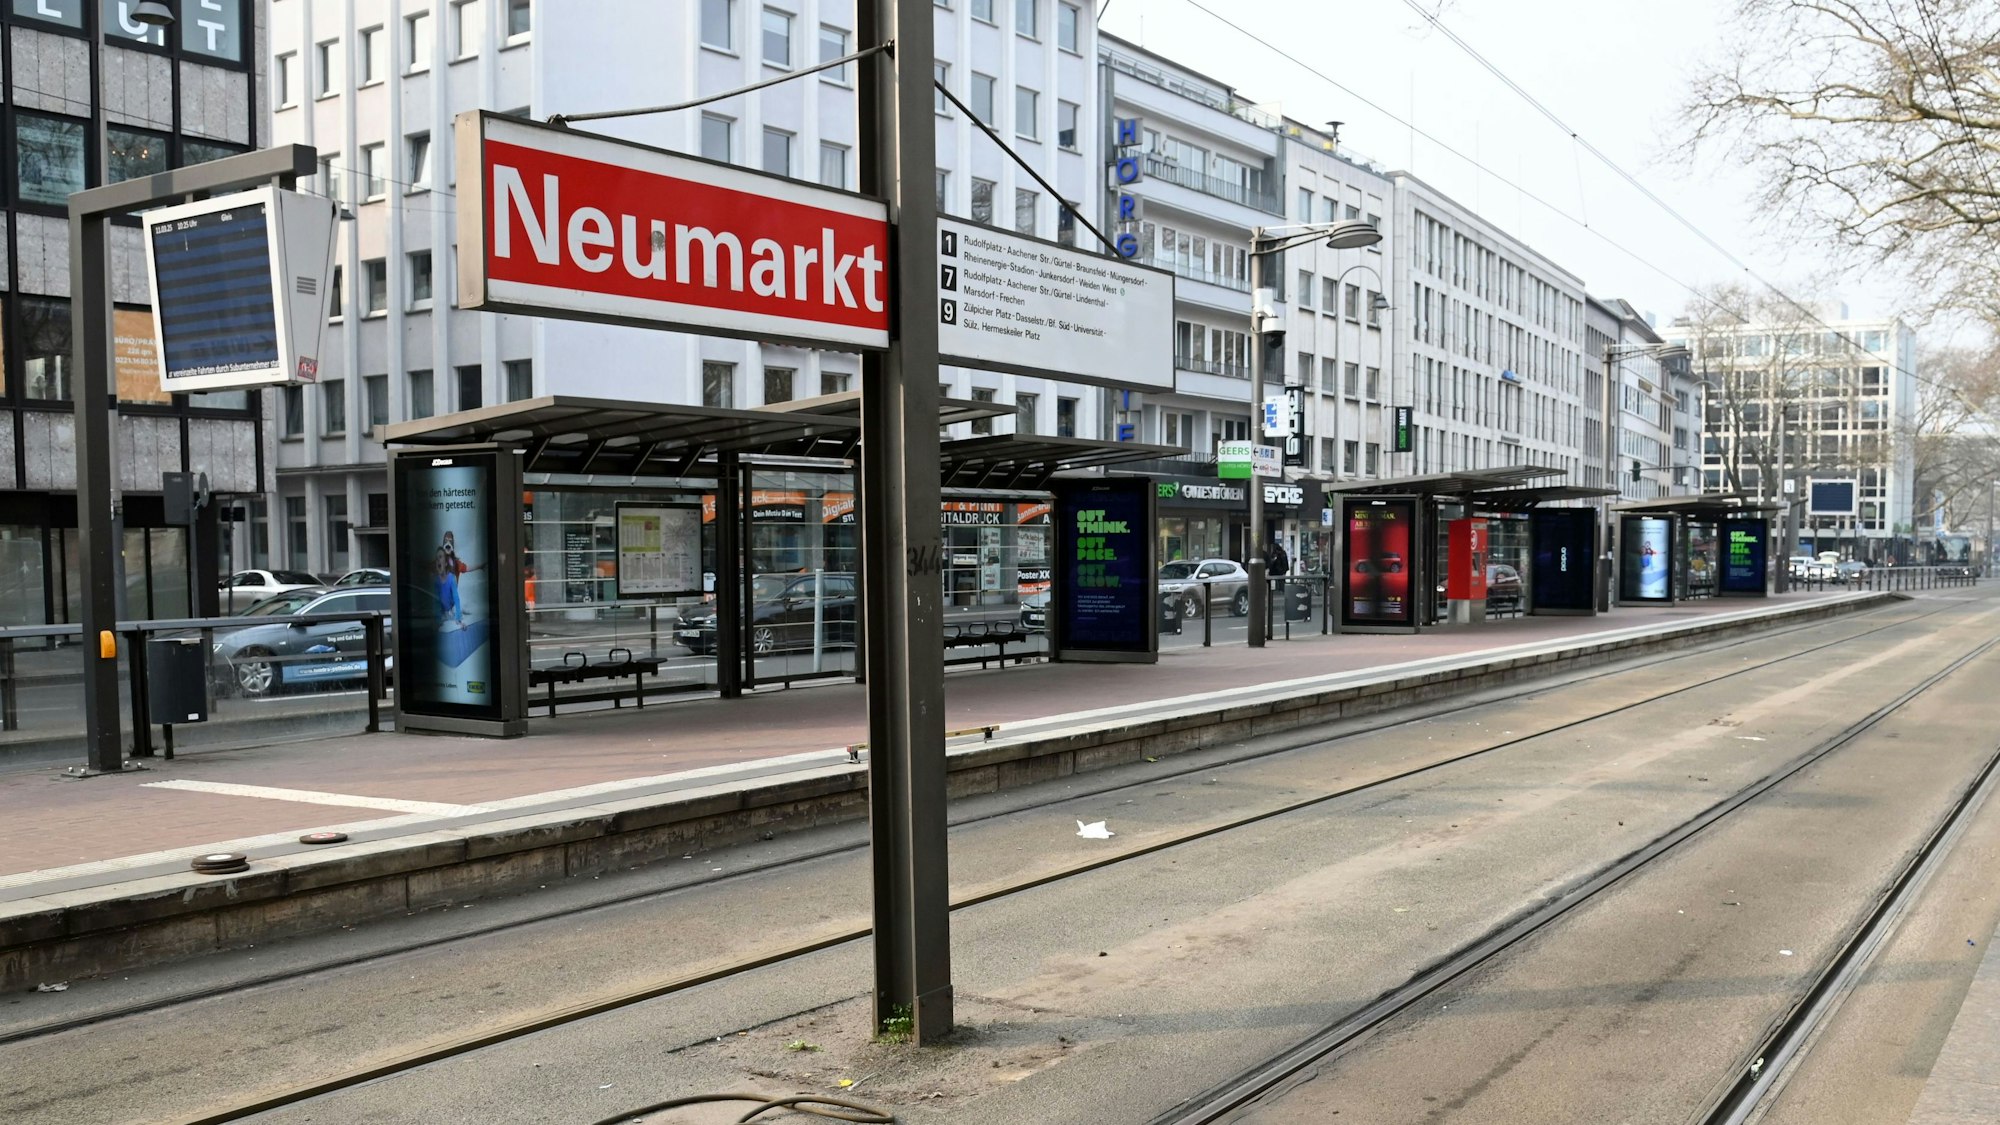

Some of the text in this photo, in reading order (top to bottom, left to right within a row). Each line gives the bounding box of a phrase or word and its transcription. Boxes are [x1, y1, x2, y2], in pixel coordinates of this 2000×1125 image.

[493, 163, 884, 313] Neumarkt
[945, 234, 952, 254] 1
[964, 235, 1002, 253] Rudolfplatz
[1007, 246, 1037, 262] Aachener
[1076, 262, 1106, 278] Braunsfeld
[1109, 271, 1144, 287] Müngersdorf
[944, 268, 954, 287] 7
[1039, 269, 1075, 284] Junkersdorf
[1079, 277, 1101, 290] Weiden
[1101, 283, 1117, 295] West
[963, 268, 1002, 287] Rudolfplatz
[1006, 279, 1037, 293] Aachener
[1075, 293, 1106, 308] Lindenthal
[963, 285, 995, 300] Marsdorf
[999, 292, 1026, 306] Frechen
[943, 302, 954, 322] 9
[963, 302, 994, 316] Zülpicher
[995, 308, 1012, 320] Platz
[1058, 320, 1070, 331] Süd
[963, 318, 1041, 341] Sülz, Hermeskeiler Platz
[1218, 446, 1250, 456] GEERS
[443, 487, 476, 498] härtesten
[445, 500, 476, 512] getestet.
[1077, 509, 1106, 522] OUT
[1077, 520, 1131, 534] THINK.
[1077, 536, 1106, 549] OUT
[1077, 548, 1118, 561] PACE.
[1017, 571, 1039, 580] Poster
[1077, 563, 1106, 576] OUT
[1077, 575, 1123, 588] GROW.
